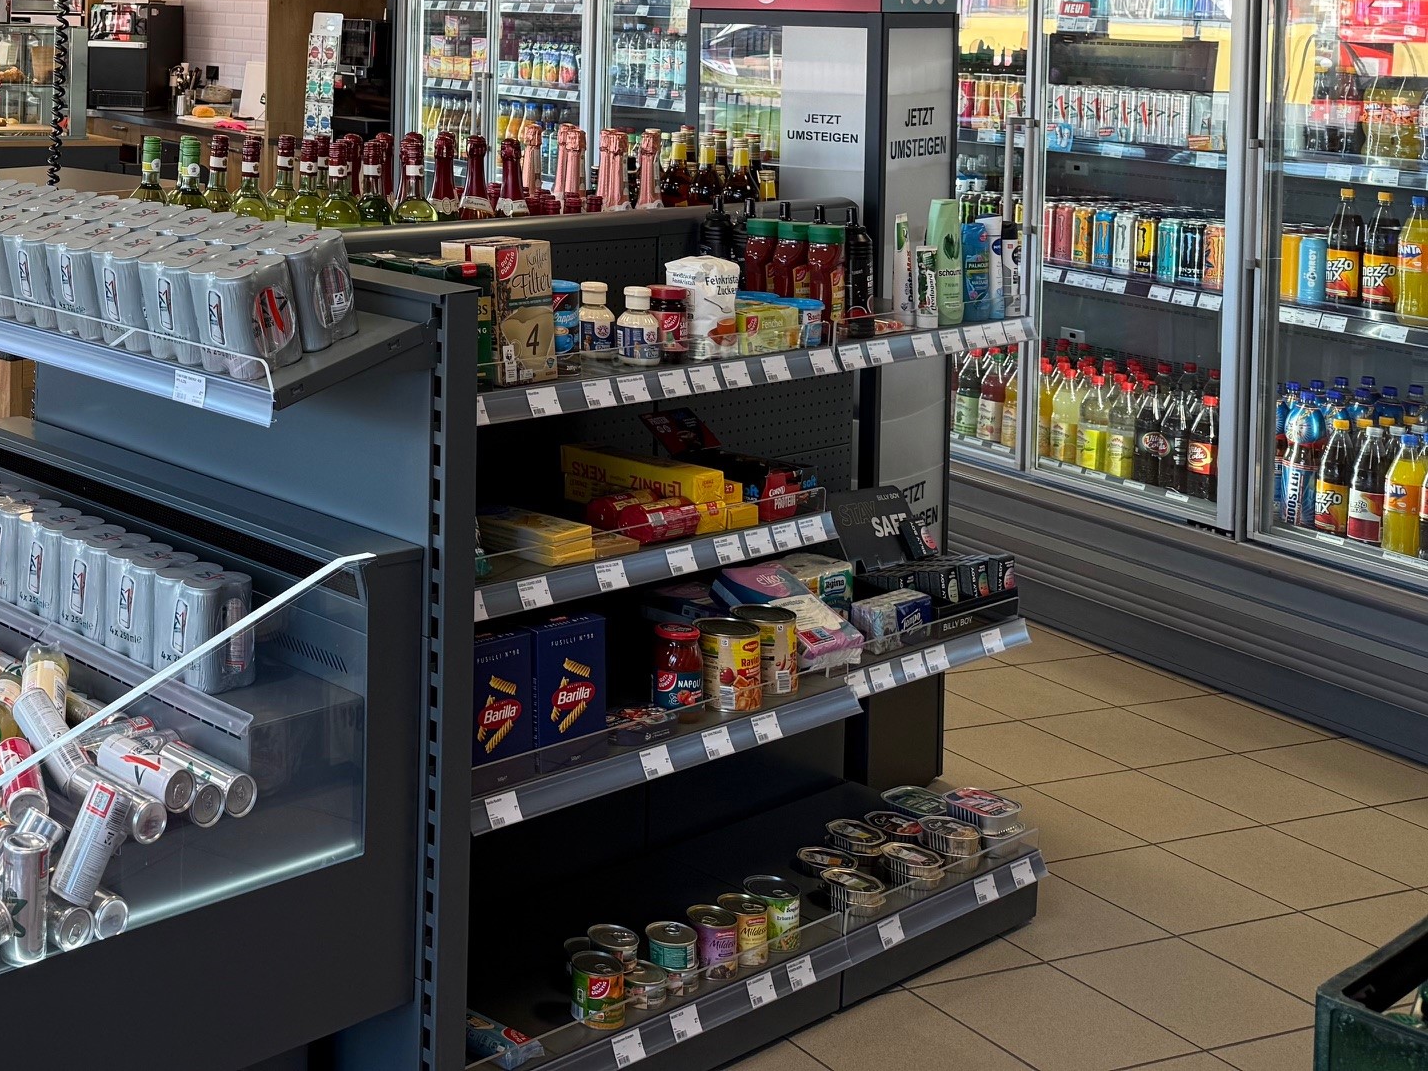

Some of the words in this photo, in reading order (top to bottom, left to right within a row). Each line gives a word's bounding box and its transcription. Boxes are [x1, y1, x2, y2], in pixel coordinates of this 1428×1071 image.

[1063, 3, 1084, 15] NEU!
[804, 113, 842, 125] JETZT
[905, 106, 935, 127] JETZT
[787, 130, 859, 144] UMSTEIGEN
[890, 136, 947, 159] UMSTEIGEN
[525, 248, 548, 269] Kaffee
[511, 267, 552, 300] Filter
[705, 275, 739, 286] Feinkrista
[761, 319, 783, 329] Fenchel
[525, 323, 540, 356] 4
[572, 461, 607, 482] KEKS
[802, 475, 817, 488] soft
[628, 475, 683, 497] LEIBNIZ
[903, 481, 926, 504] ETZT
[774, 495, 796, 511] PROTEIN
[876, 493, 890, 501] BILLY
[1286, 470, 1300, 526] BOOSTER
[838, 500, 876, 527] STAY
[756, 573, 785, 586] elkos
[902, 609, 923, 632] Tempo
[943, 619, 959, 632] BILLY
[550, 637, 576, 647] FUSILLI
[476, 653, 502, 664] FUSILLI
[557, 686, 591, 706] Barilla
[483, 704, 517, 724] Barilla
